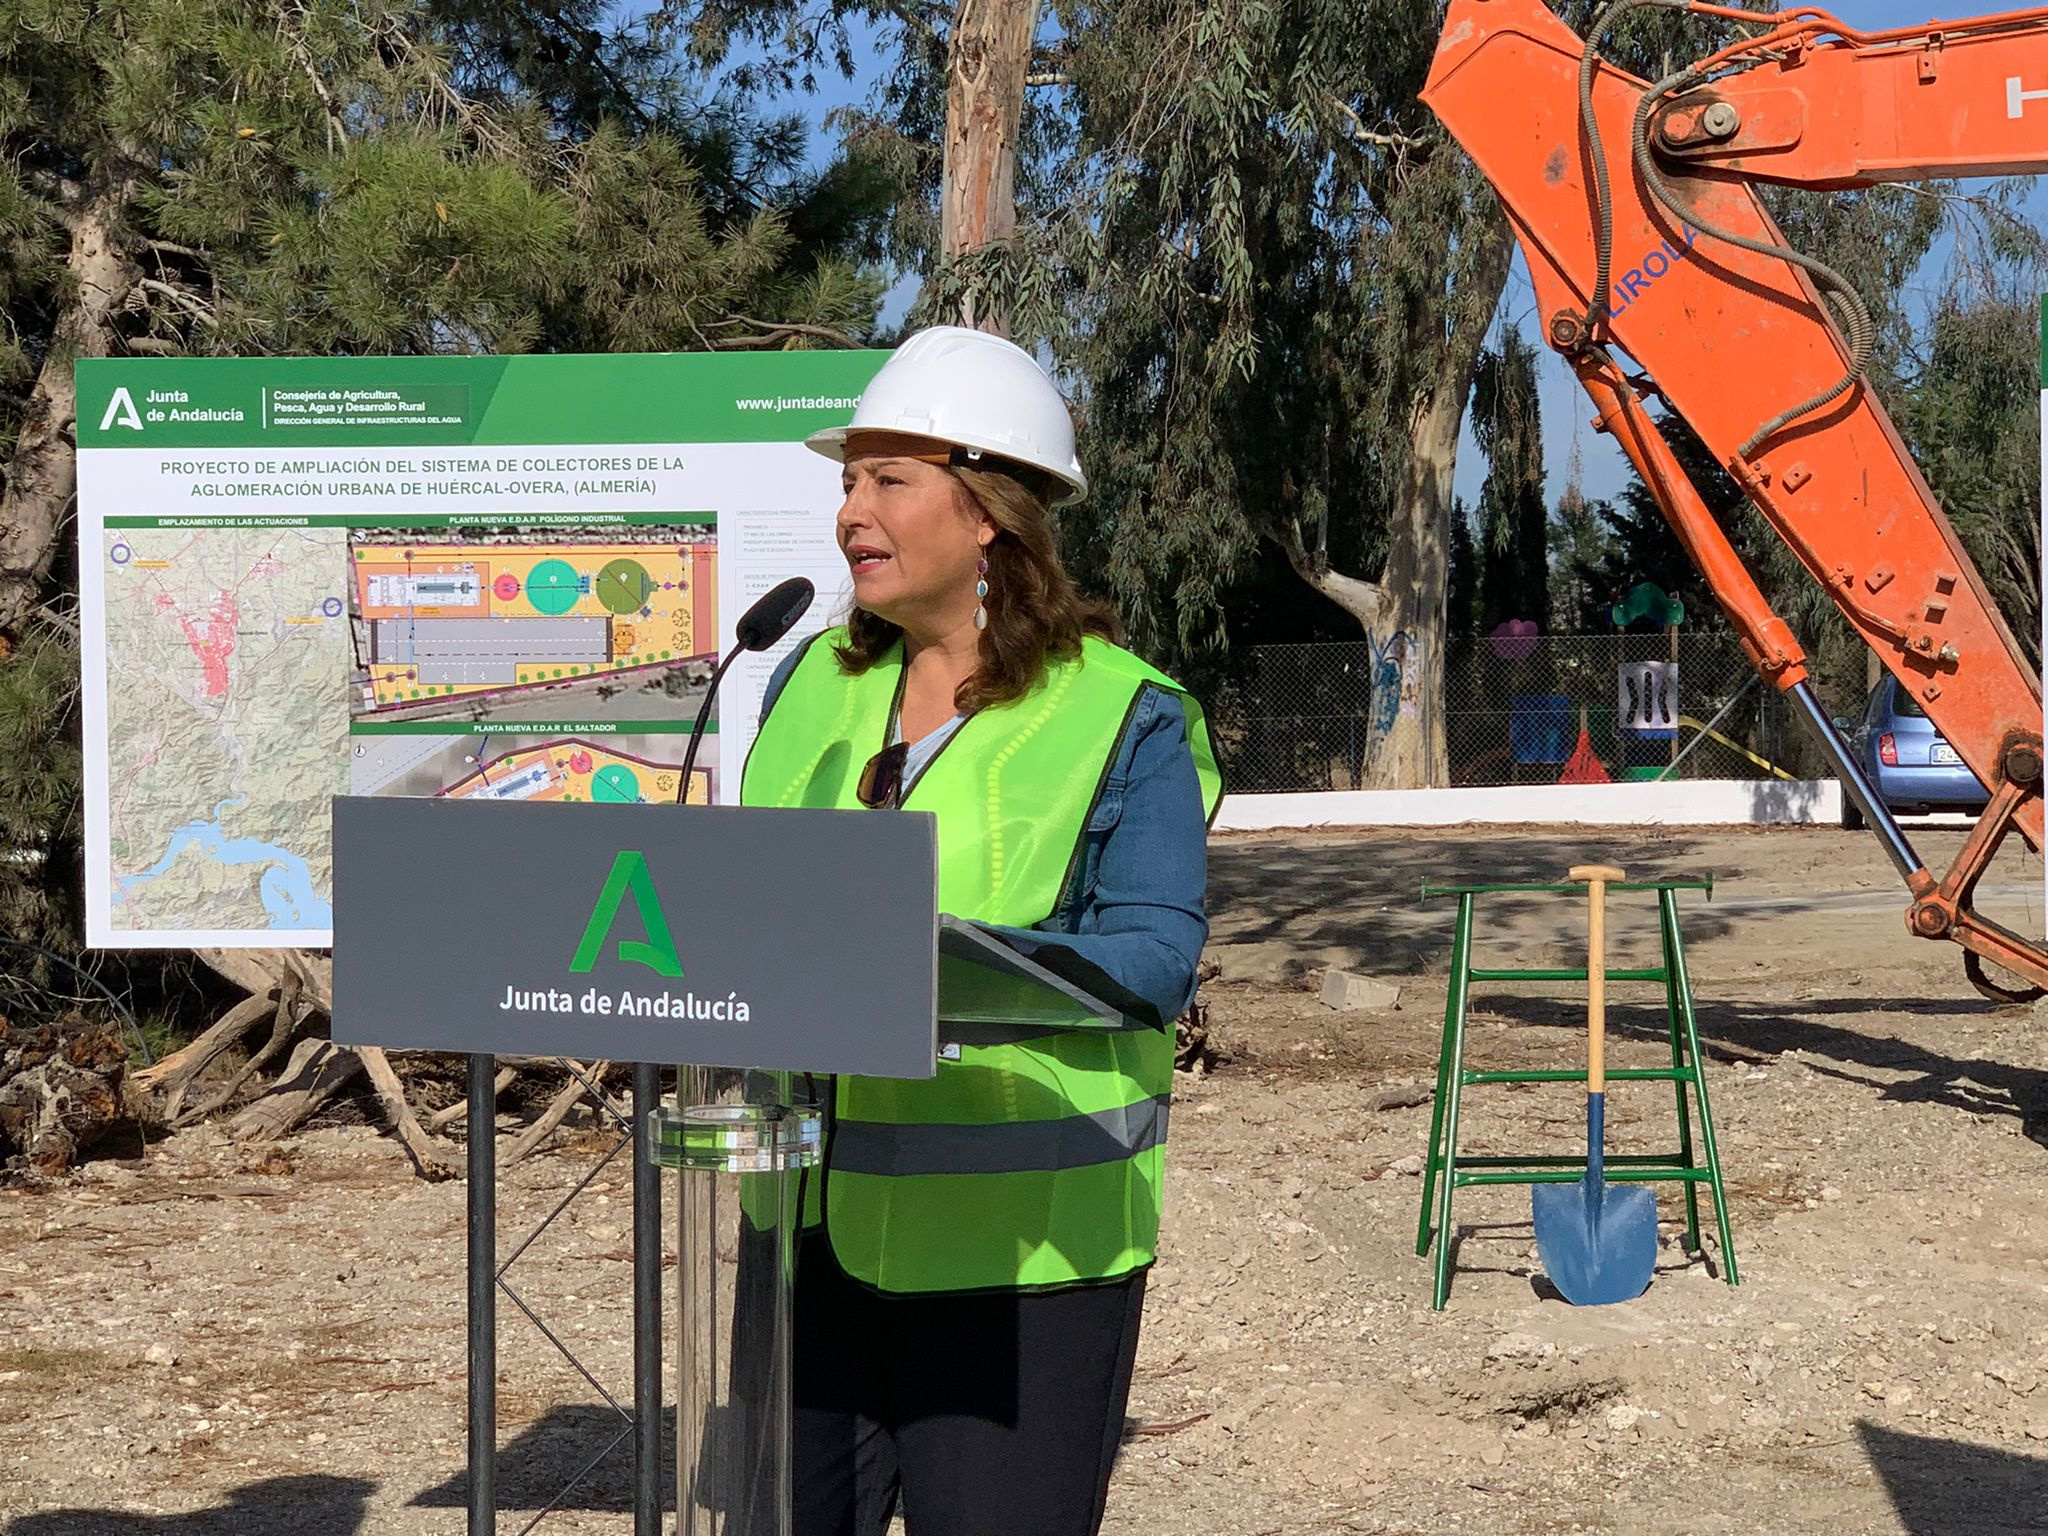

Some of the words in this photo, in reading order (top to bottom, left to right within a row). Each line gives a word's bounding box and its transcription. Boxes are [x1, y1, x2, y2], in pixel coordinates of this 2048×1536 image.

[1602, 223, 1699, 319] LIROLA
[146, 389, 189, 403] Junta
[273, 390, 327, 402] Consejería
[328, 390, 342, 400] de
[343, 390, 401, 402] Agricultura,
[146, 408, 165, 422] de
[169, 408, 244, 422] Andalucía
[274, 403, 308, 414] Pesca,
[309, 403, 336, 415] Agua
[337, 405, 344, 415] y
[345, 402, 397, 413] Desarrollo
[398, 402, 426, 412] Rural
[274, 416, 312, 425] DIRECCIÓN
[312, 417, 345, 425] GENERAL
[356, 416, 427, 425] INFRAESTRUCTURAS
[427, 416, 441, 424] DEL
[441, 416, 462, 424] AGUA
[160, 461, 250, 475] PROYECTO
[255, 461, 277, 474] DE
[281, 458, 381, 474] AMPLIACIÓN
[386, 460, 417, 473] DEL
[422, 459, 492, 473] SISTEMA
[496, 459, 518, 472] DE
[522, 458, 632, 472] COLECTORES
[637, 457, 658, 471] DE
[663, 457, 684, 470] LA
[191, 480, 322, 497] AGLOMERACIÓN
[328, 482, 396, 496] URBANA
[400, 482, 422, 495] DE
[427, 479, 569, 496] HUÉRCAL-OVERA,
[574, 477, 657, 496] (ALMERÍA)
[158, 518, 223, 526] EMPLAZAMIENTO
[254, 517, 309, 525] ACTUACIONES
[449, 516, 480, 524] PLANTA
[481, 516, 508, 524] NUEVA
[539, 514, 580, 523] POLÍGONO
[581, 515, 627, 523] INDUSTRIAL
[474, 724, 505, 733] PLANTA
[505, 724, 532, 732] NUEVA
[563, 724, 574, 732] EL
[575, 724, 617, 732] SALTADOR
[499, 985, 573, 1013] Junta
[580, 987, 612, 1015] de
[617, 990, 750, 1023] Andalucía
